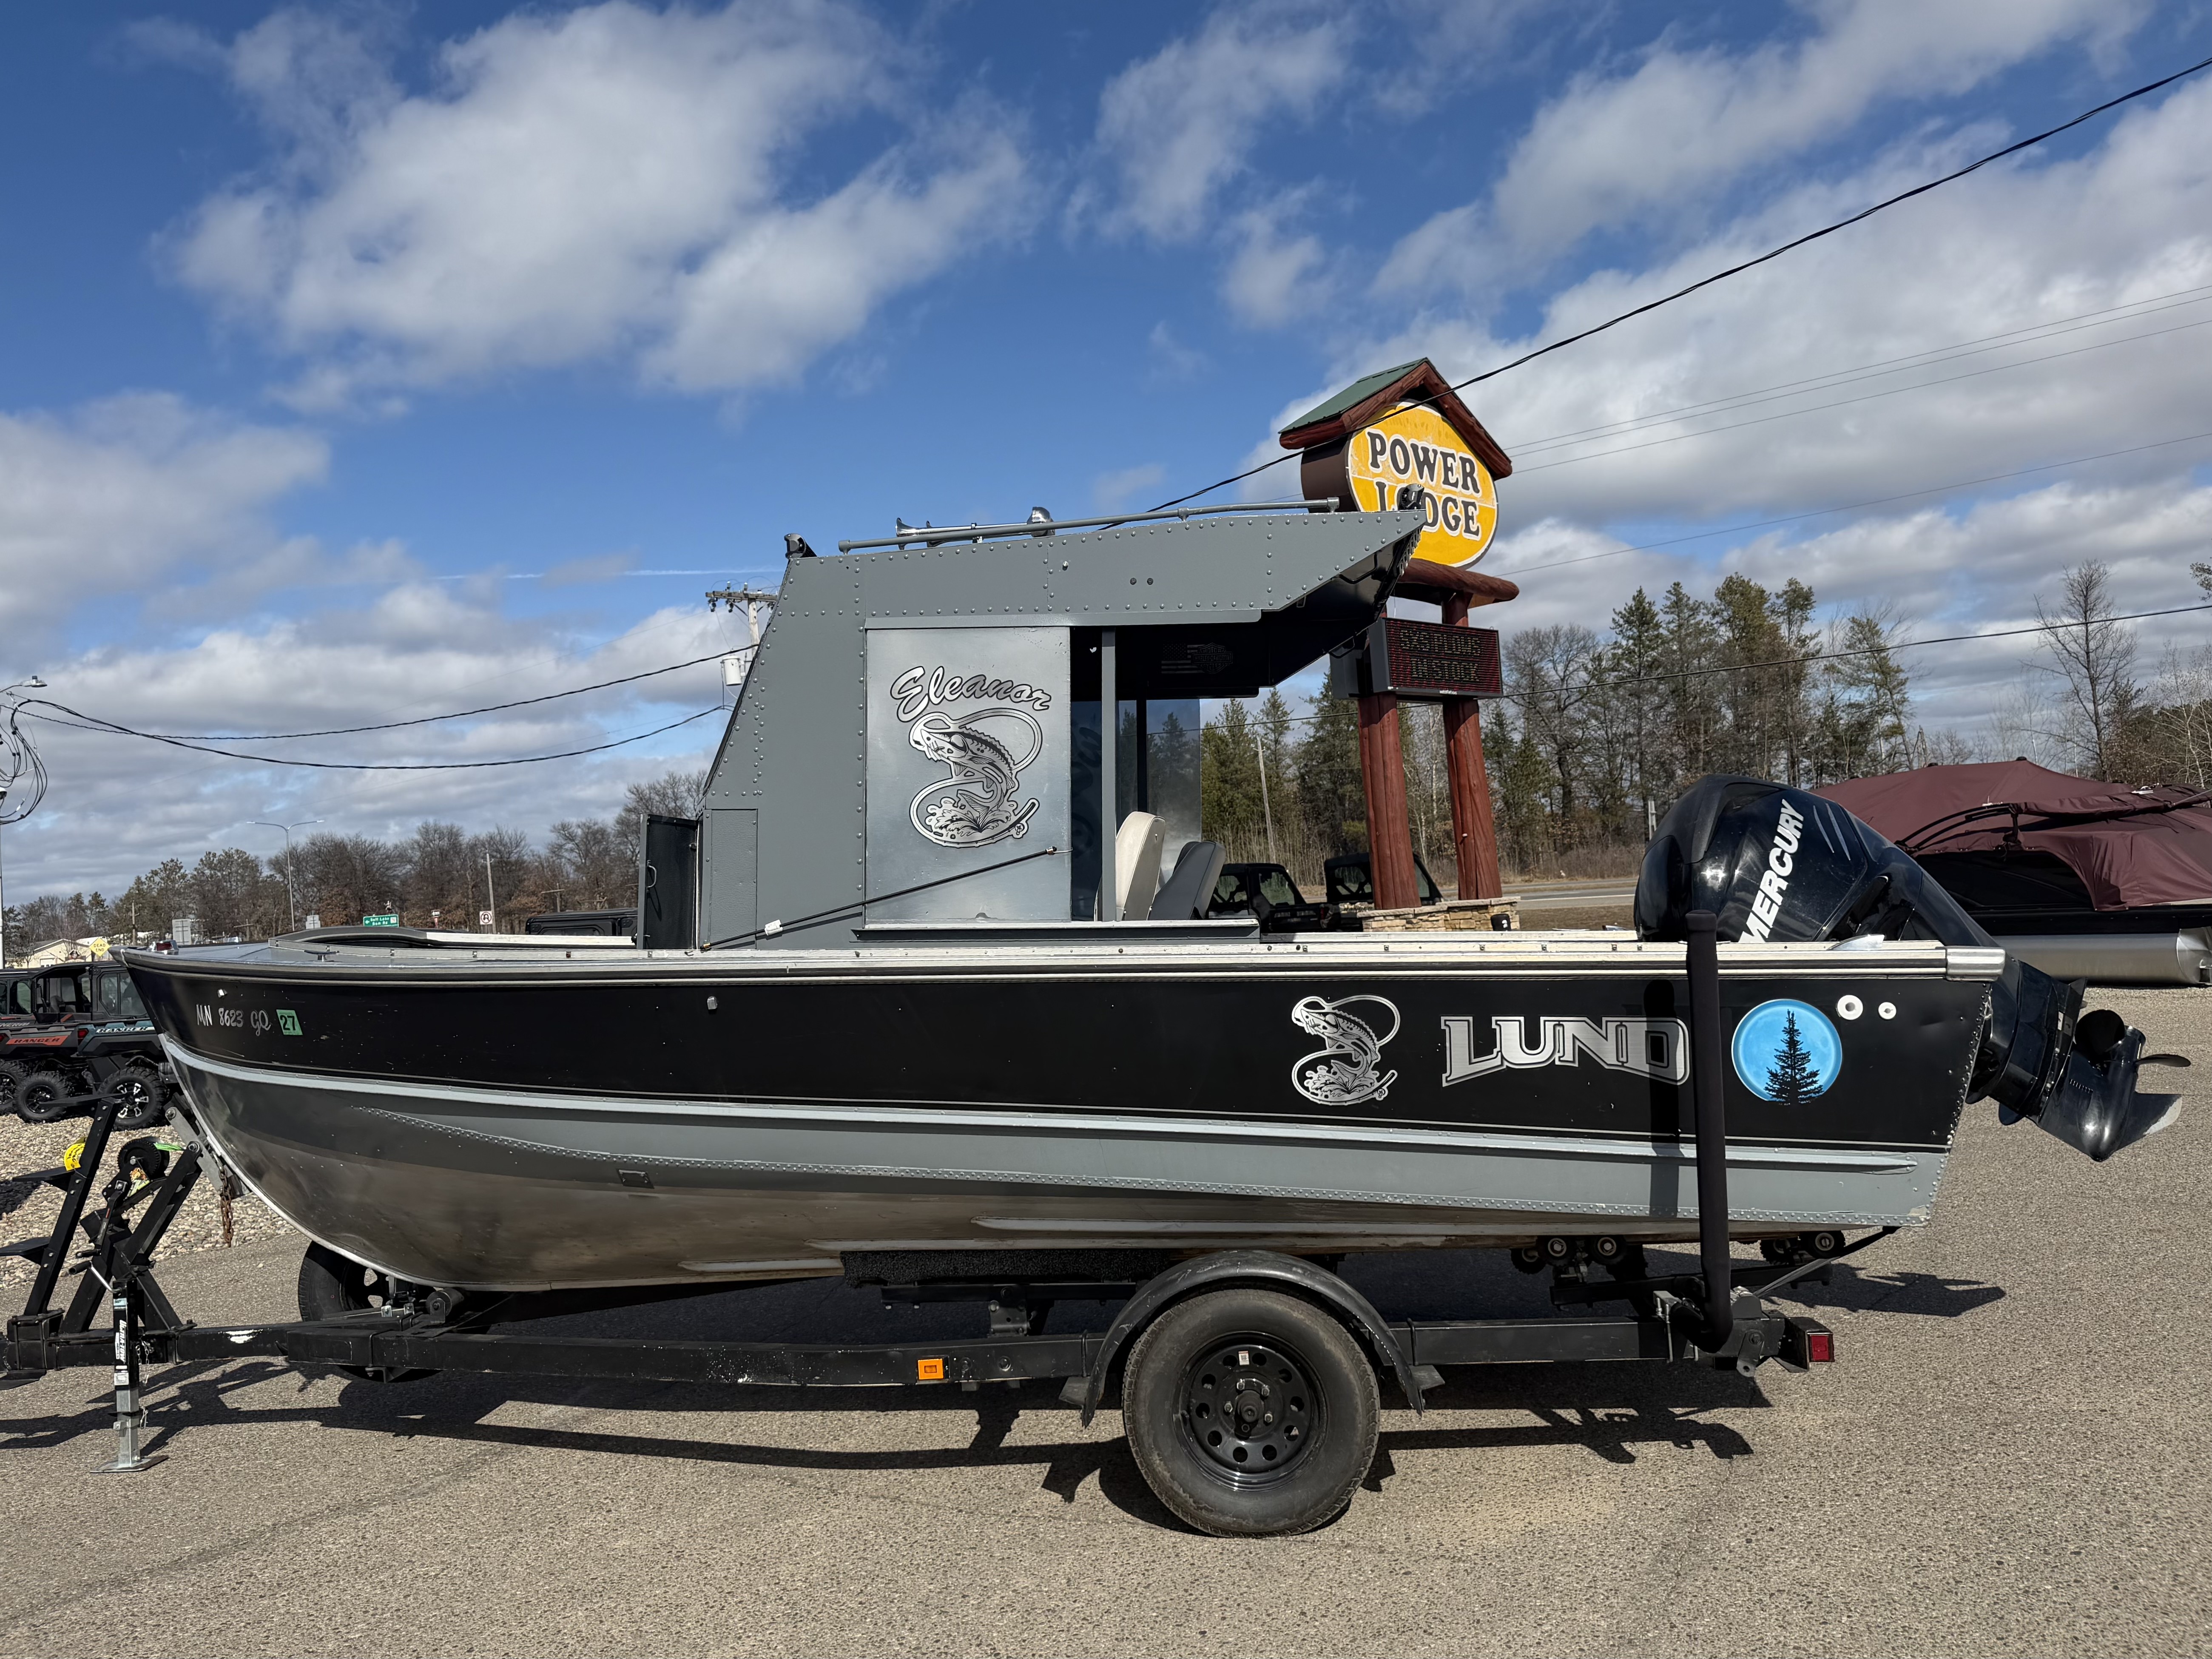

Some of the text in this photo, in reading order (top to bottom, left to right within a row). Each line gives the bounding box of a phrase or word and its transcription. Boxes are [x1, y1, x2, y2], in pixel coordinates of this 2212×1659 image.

[1367, 431, 1480, 494] POWER
[1375, 481, 1480, 538] LDGE
[890, 666, 1052, 723] Eleanor
[1738, 798, 1805, 942] MERCURY
[196, 1004, 213, 1026] MN
[218, 1007, 244, 1027] 8623
[280, 1015, 297, 1031] 27
[1441, 1015, 1690, 1086] LUND
